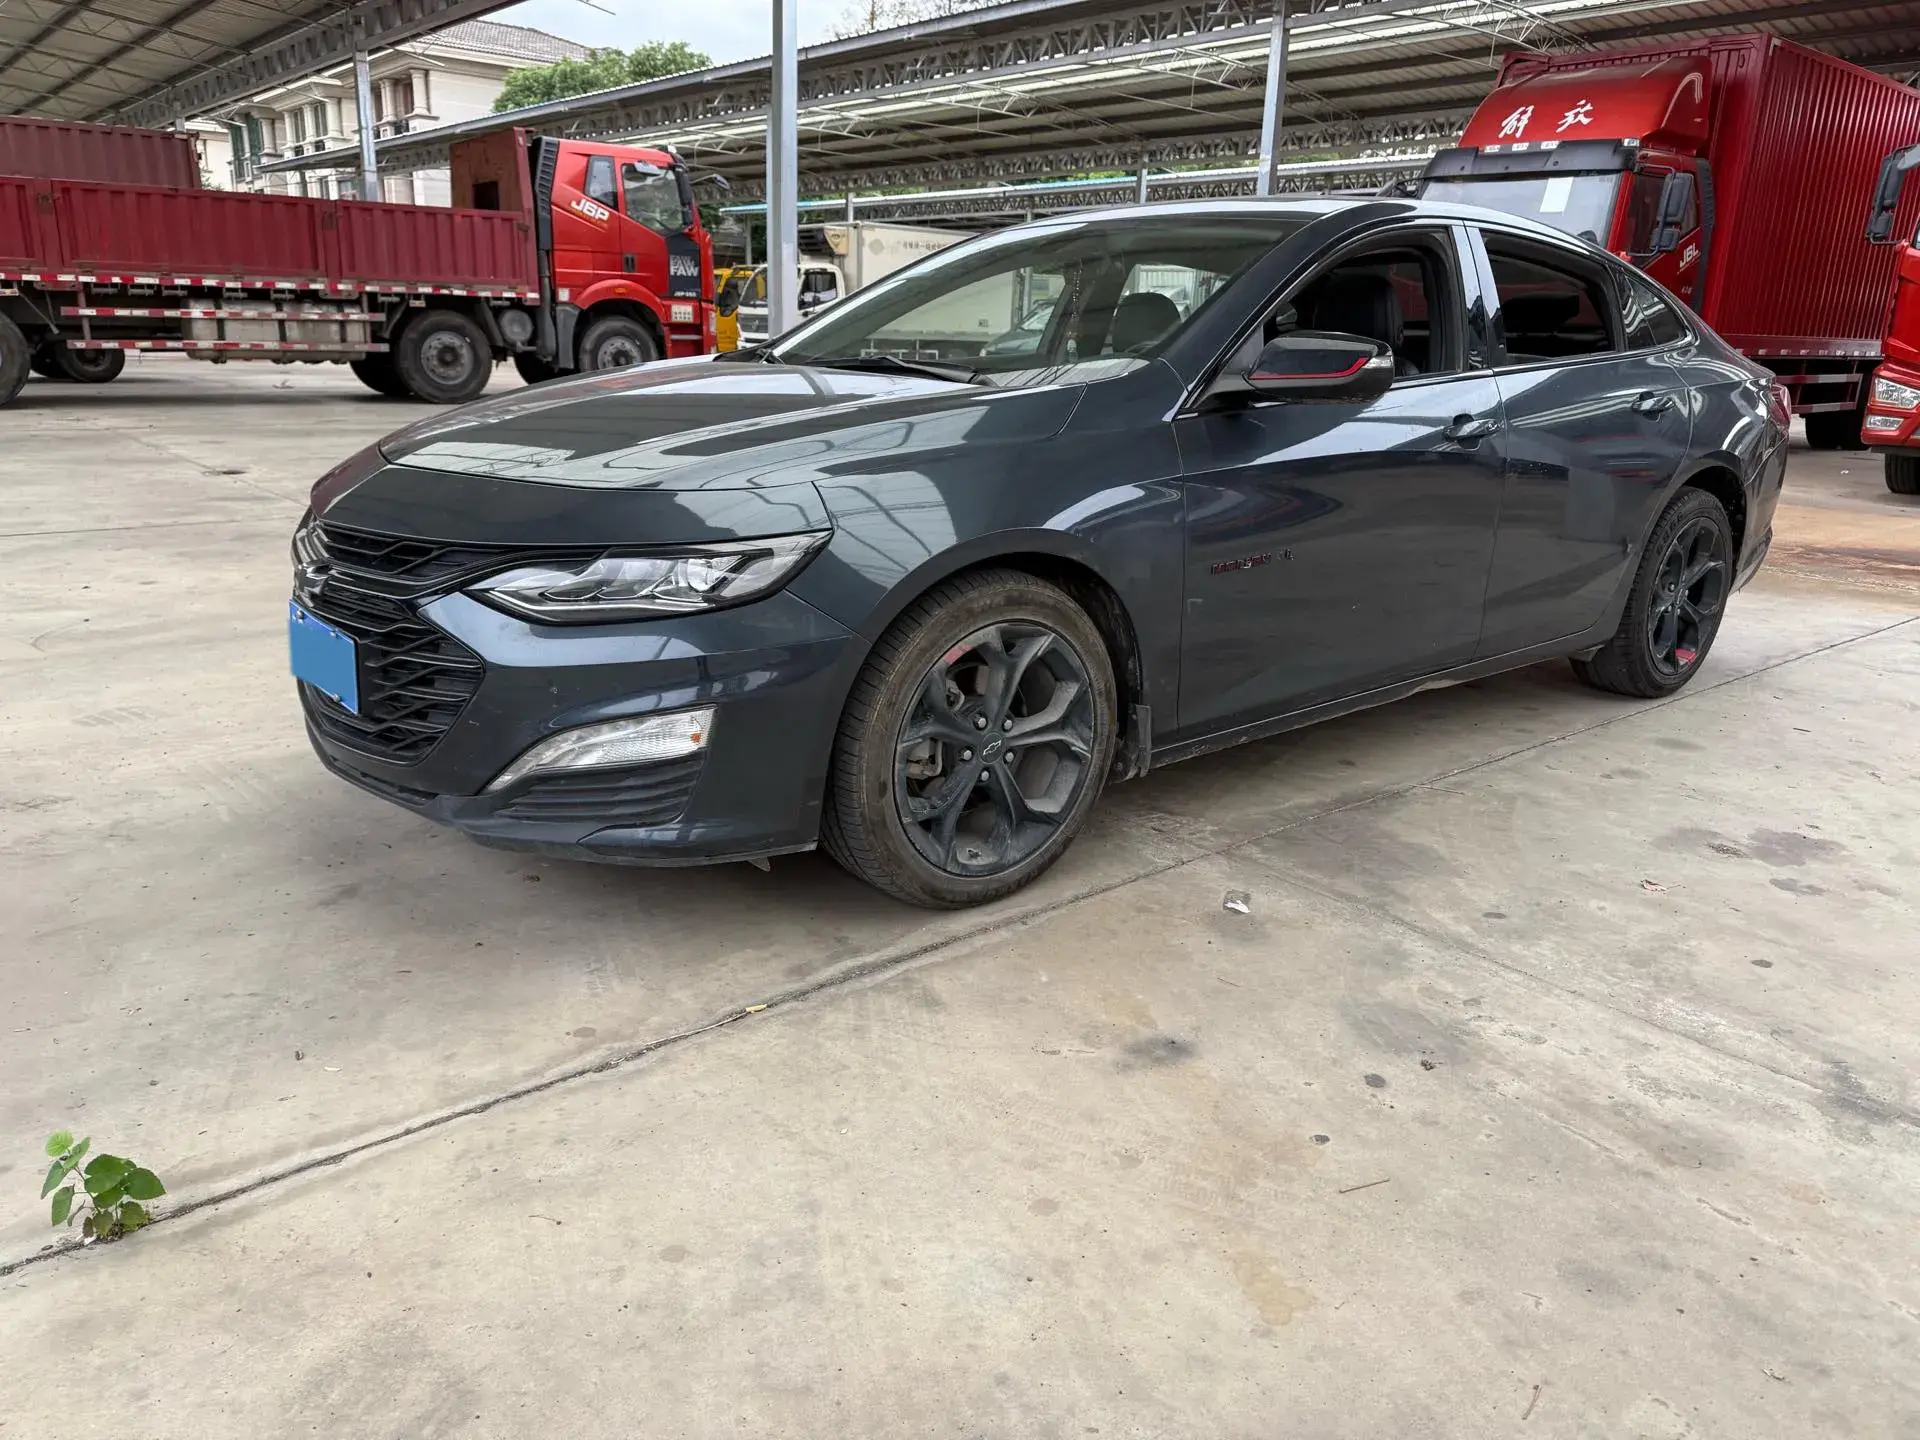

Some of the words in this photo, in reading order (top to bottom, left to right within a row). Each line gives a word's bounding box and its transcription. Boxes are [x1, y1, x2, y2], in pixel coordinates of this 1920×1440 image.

[1498, 99, 1594, 138] 解放
[1679, 242, 1699, 267] J6L
[669, 265, 699, 277] FAW
